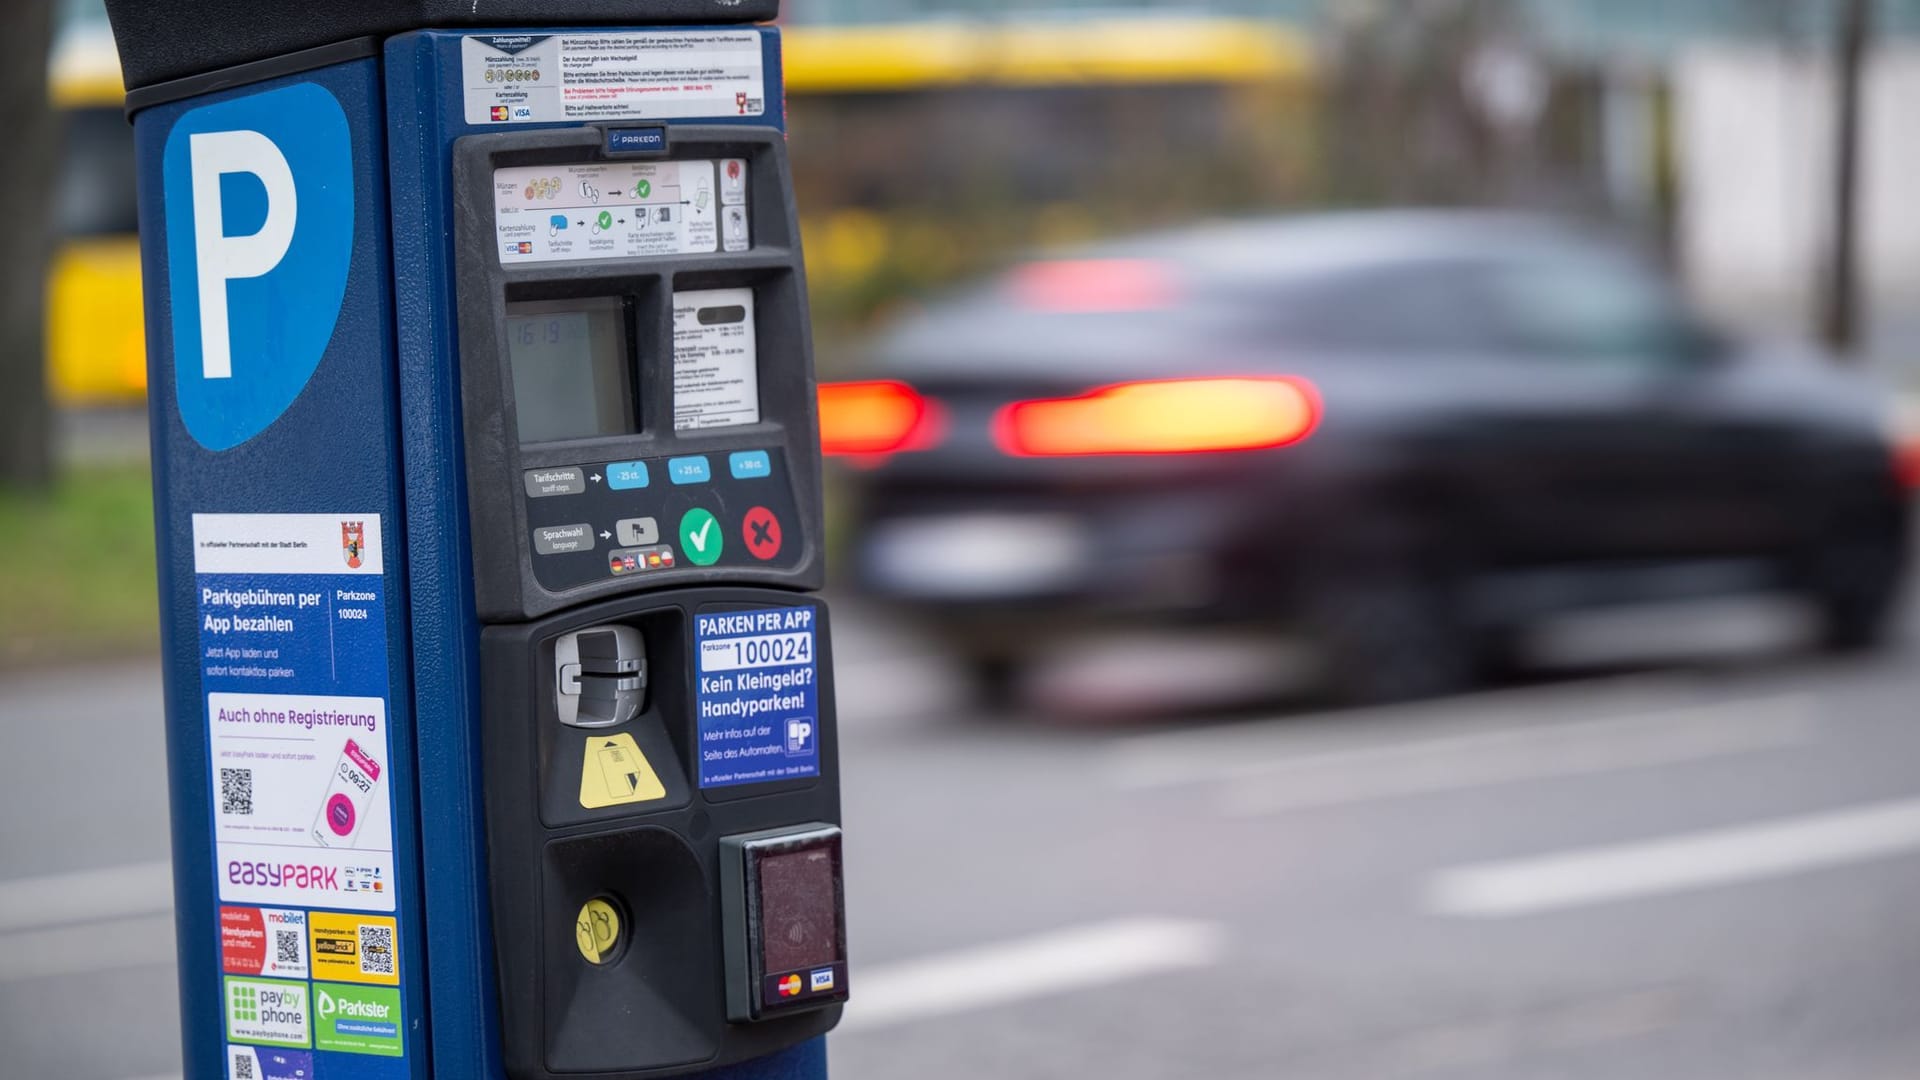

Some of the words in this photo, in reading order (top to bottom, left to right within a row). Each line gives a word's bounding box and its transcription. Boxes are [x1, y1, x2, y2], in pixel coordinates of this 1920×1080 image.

[514, 108, 530, 117] VISA
[498, 224, 536, 233] Kartenzahlung
[190, 129, 297, 379] P
[534, 471, 576, 483] Tarifschritte
[543, 527, 584, 542] Sprachwahl
[202, 588, 295, 609] Parkgebühren
[298, 592, 322, 610] per
[337, 590, 376, 601] Parkzone
[338, 608, 368, 620] 100024
[204, 615, 231, 635] App
[233, 615, 294, 633] bezahlen
[700, 614, 754, 636] PARKEN
[757, 613, 782, 632] PER
[784, 610, 812, 630] APP
[205, 647, 224, 658] Jetzt
[225, 647, 241, 660] App
[241, 648, 262, 658] laden
[263, 648, 279, 659] und
[702, 643, 731, 652] Parkzone
[734, 636, 809, 666] 100024
[206, 665, 228, 676] sofort
[229, 666, 267, 677] kontaktlos
[268, 666, 295, 679] parken
[701, 676, 733, 695] Kein
[737, 667, 813, 692] Kleingeld?
[701, 691, 805, 719] Handyparken!
[218, 708, 251, 723] Auch
[253, 708, 286, 724] ohne
[288, 709, 376, 732] Registrierung
[703, 731, 723, 742] Mehr
[724, 729, 743, 740] Infos
[743, 727, 757, 738] auf
[758, 725, 771, 736] der
[703, 750, 723, 762] Seite
[724, 748, 738, 760] des
[739, 745, 785, 758] Automaten.
[348, 769, 371, 793] 09:27
[268, 912, 304, 925] mobilet
[222, 926, 265, 939] Handyparken
[223, 938, 236, 947] und
[814, 975, 830, 985] VISA
[261, 1007, 302, 1025] phone
[338, 998, 390, 1019] Parkster
[234, 1028, 303, 1041] www.paybyphone.com
